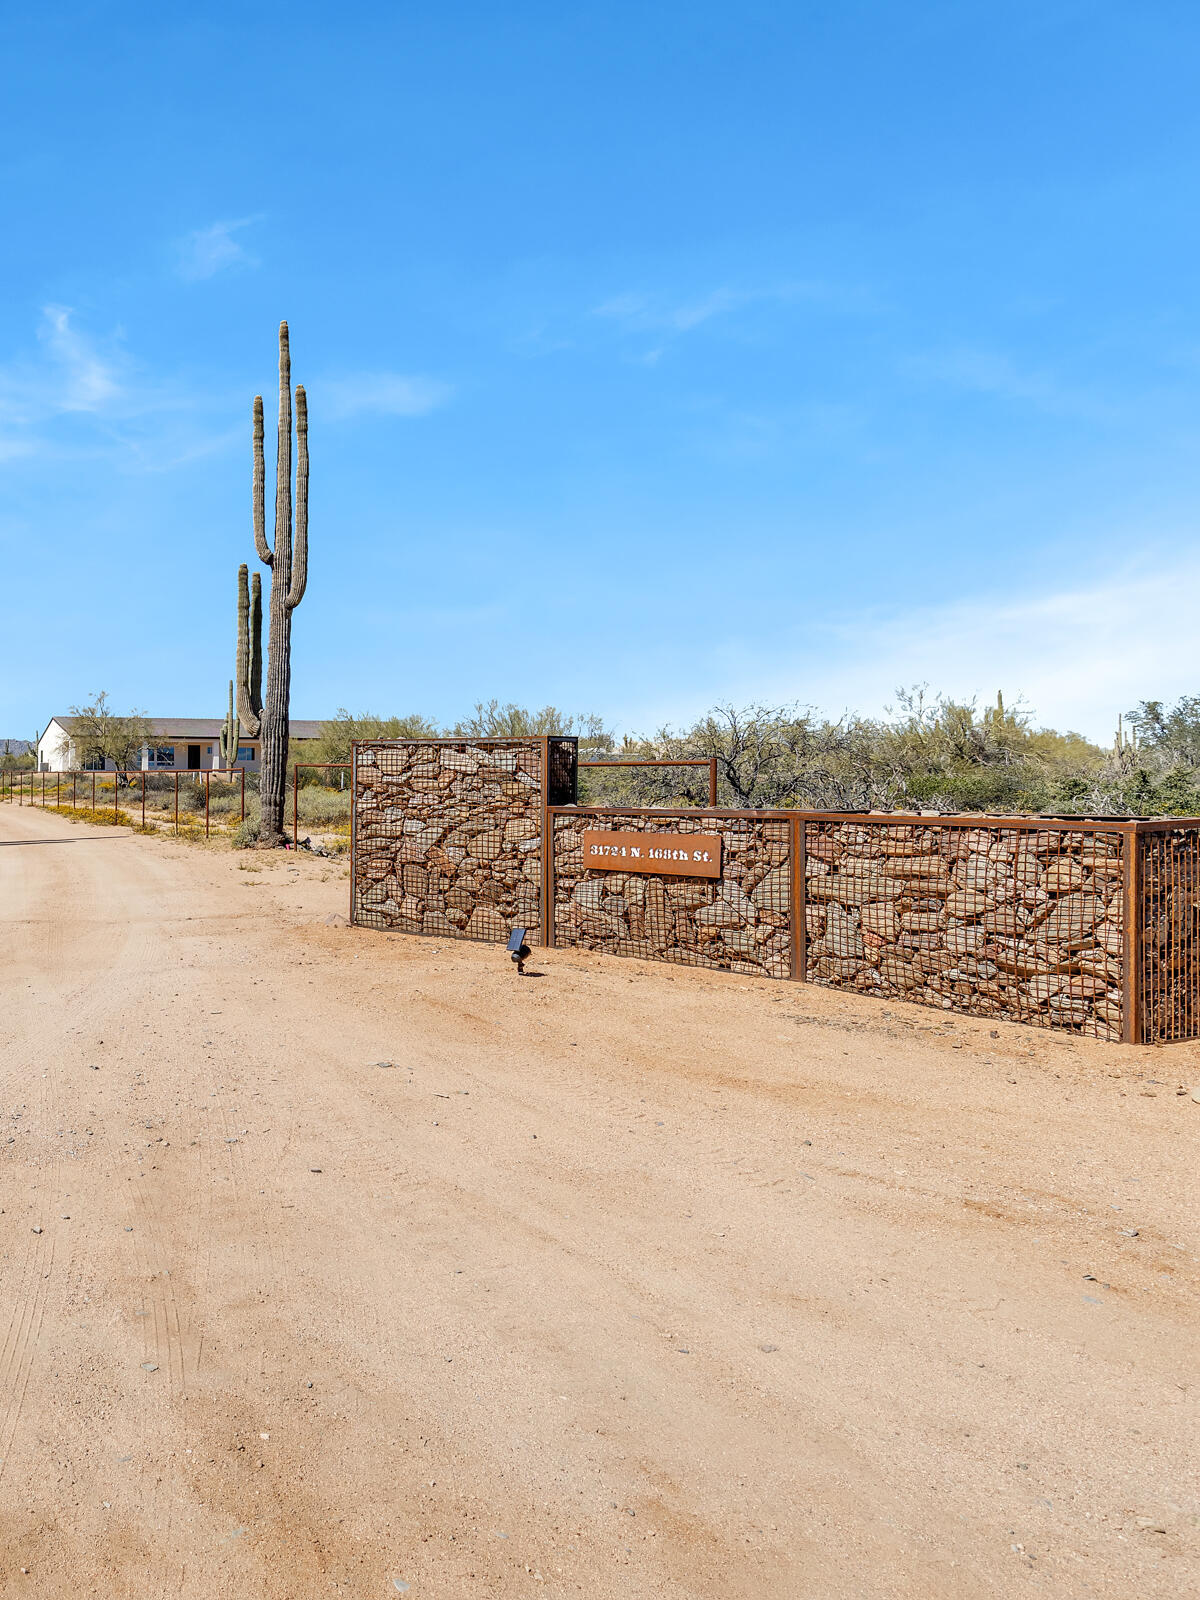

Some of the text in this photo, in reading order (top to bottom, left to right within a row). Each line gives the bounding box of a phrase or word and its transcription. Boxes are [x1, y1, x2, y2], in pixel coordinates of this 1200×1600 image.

[590, 844, 713, 862] 31724 N. 168th St.
